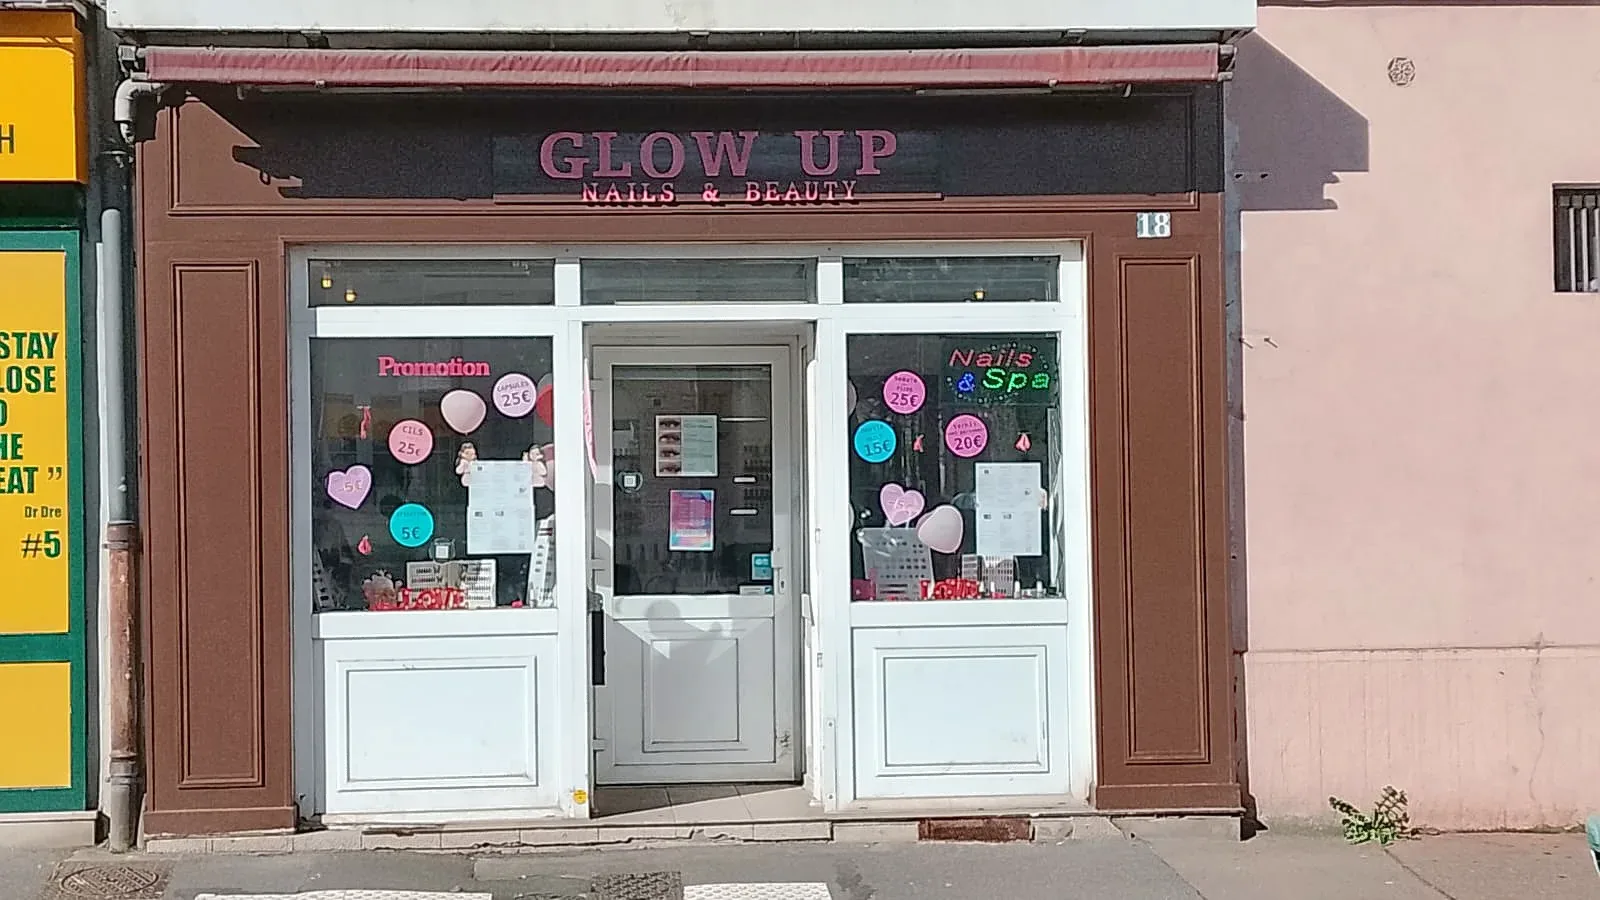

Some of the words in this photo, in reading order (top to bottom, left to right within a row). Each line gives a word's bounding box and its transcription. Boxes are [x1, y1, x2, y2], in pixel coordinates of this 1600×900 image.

[540, 131, 759, 179] GLOW
[795, 130, 897, 176] UP
[582, 182, 676, 202] NAILS
[702, 182, 721, 202] &
[745, 180, 857, 202] BEAUTY
[1138, 212, 1171, 238] 18
[0, 331, 59, 359] STAY
[378, 356, 491, 376] Promotion
[949, 349, 1033, 367] Nails
[958, 371, 976, 392] &
[982, 368, 1050, 393] Spa
[501, 390, 531, 407] 25€
[890, 391, 919, 407] 25€
[402, 425, 424, 437] CILS
[398, 441, 421, 457] 25€
[864, 440, 892, 456] 15€
[954, 435, 983, 450] 20€
[25, 506, 38, 518] Dr
[41, 506, 62, 518] Dre
[402, 526, 421, 541] 5€
[21, 530, 61, 558] #5
